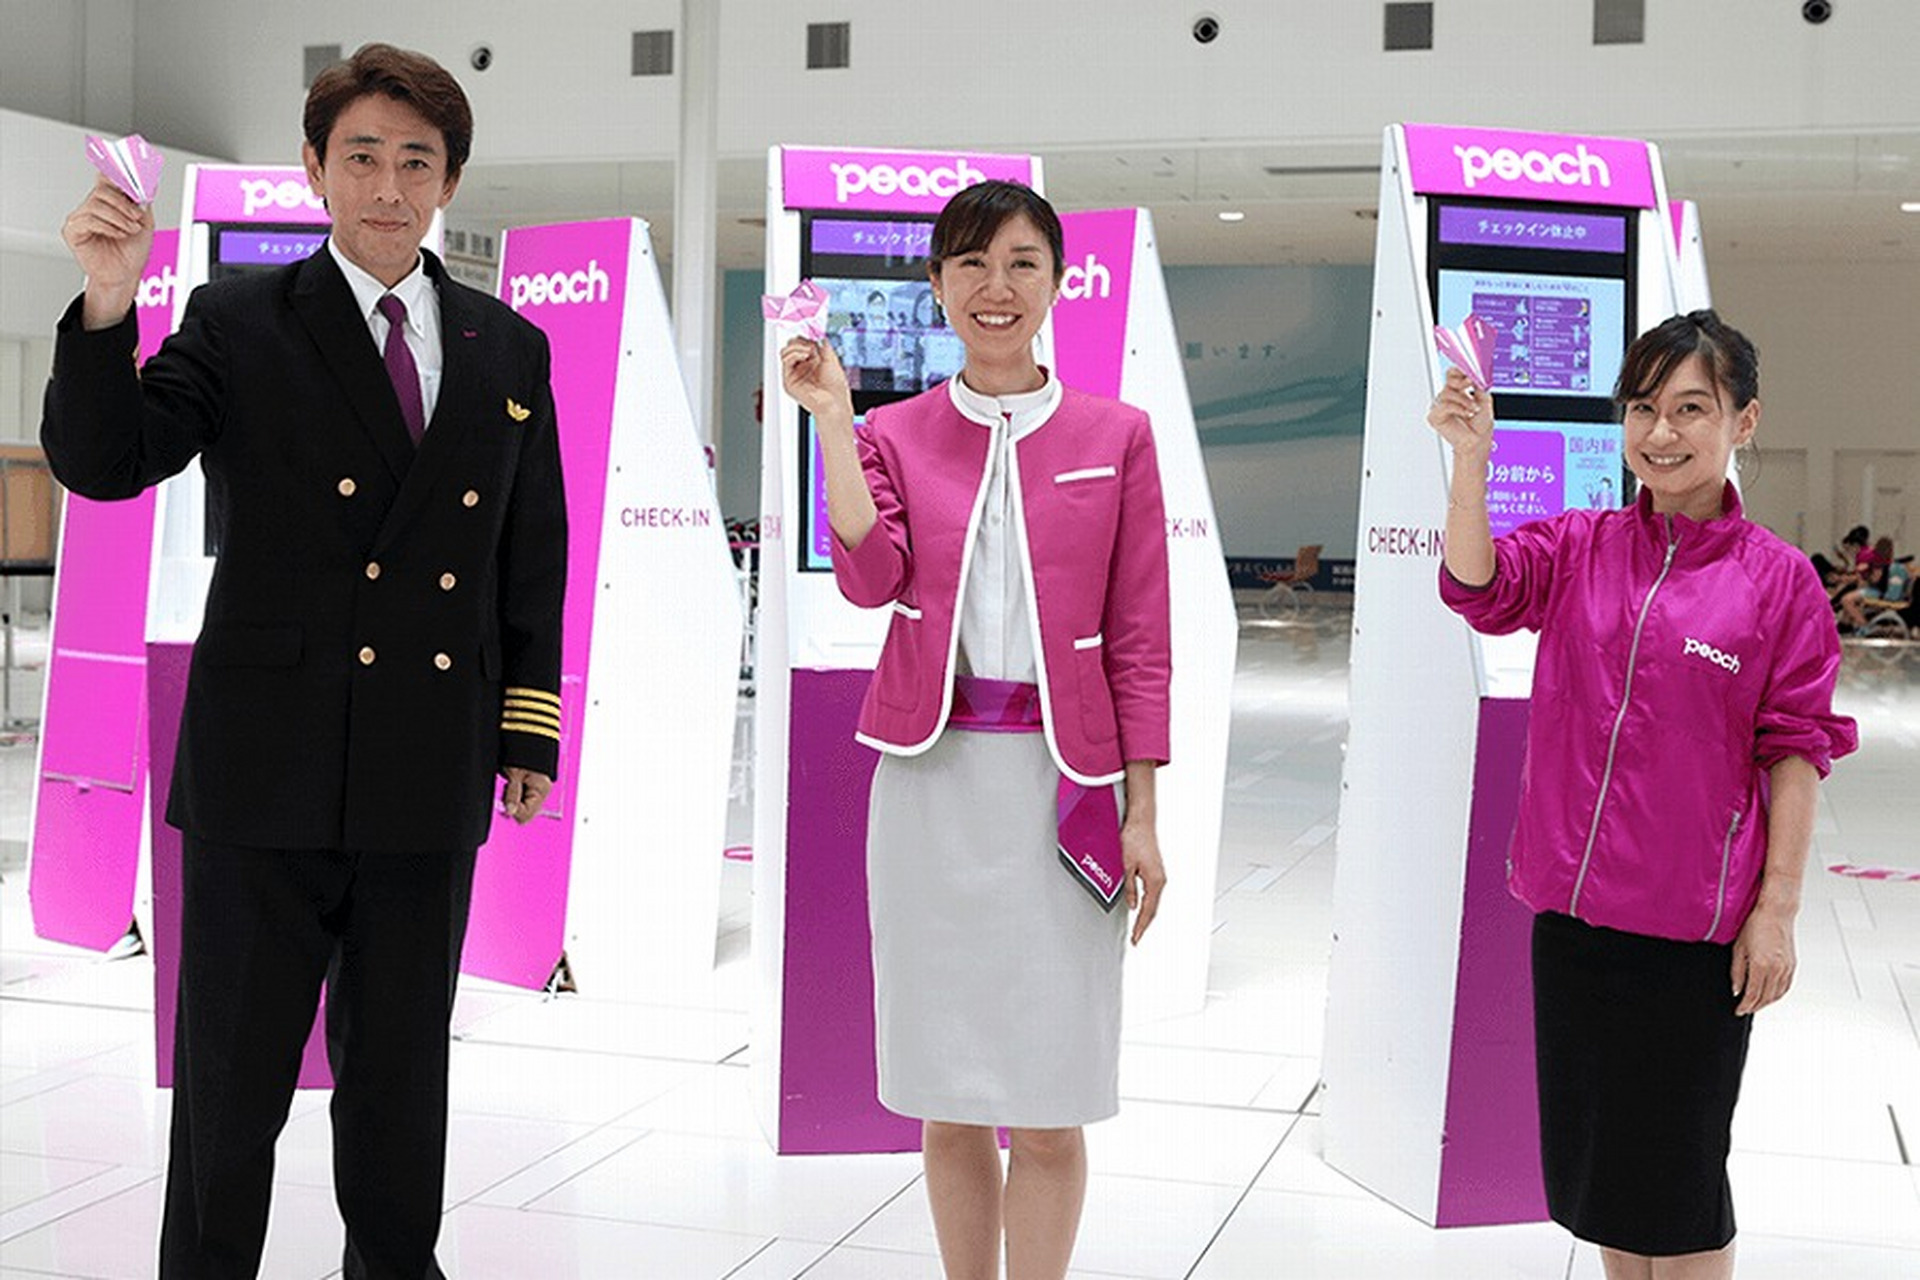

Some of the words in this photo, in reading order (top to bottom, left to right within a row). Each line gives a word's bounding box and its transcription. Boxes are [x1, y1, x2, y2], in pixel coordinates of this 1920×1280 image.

[829, 158, 987, 203] peach
[1453, 143, 1611, 188] peach
[1477, 219, 1587, 240] チェックイン休止中
[509, 259, 610, 313] peach
[1057, 253, 1111, 300] ch
[620, 507, 711, 528] CHECK-IN
[1368, 526, 1446, 557] CHECK-IN
[1683, 637, 1741, 675] peach
[1081, 853, 1113, 889] peach
